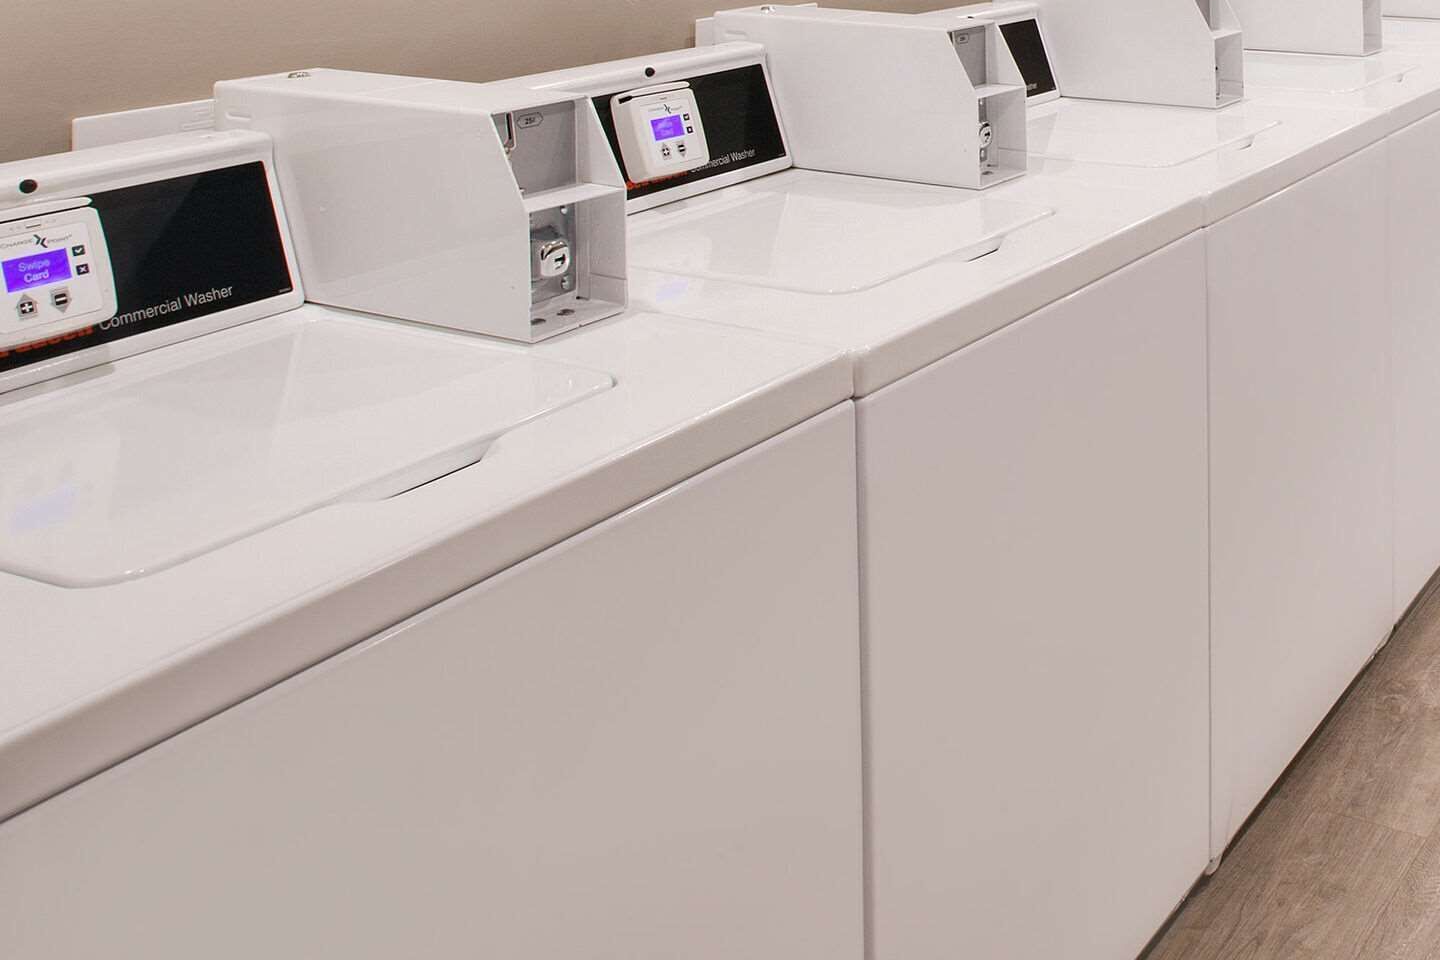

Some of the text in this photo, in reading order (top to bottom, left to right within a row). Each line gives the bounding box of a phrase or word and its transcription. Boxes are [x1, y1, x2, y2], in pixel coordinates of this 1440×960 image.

[730, 149, 755, 162] Washer
[18, 259, 51, 272] Swipe
[24, 269, 50, 283] Card
[100, 285, 233, 331] Commercial Washer
